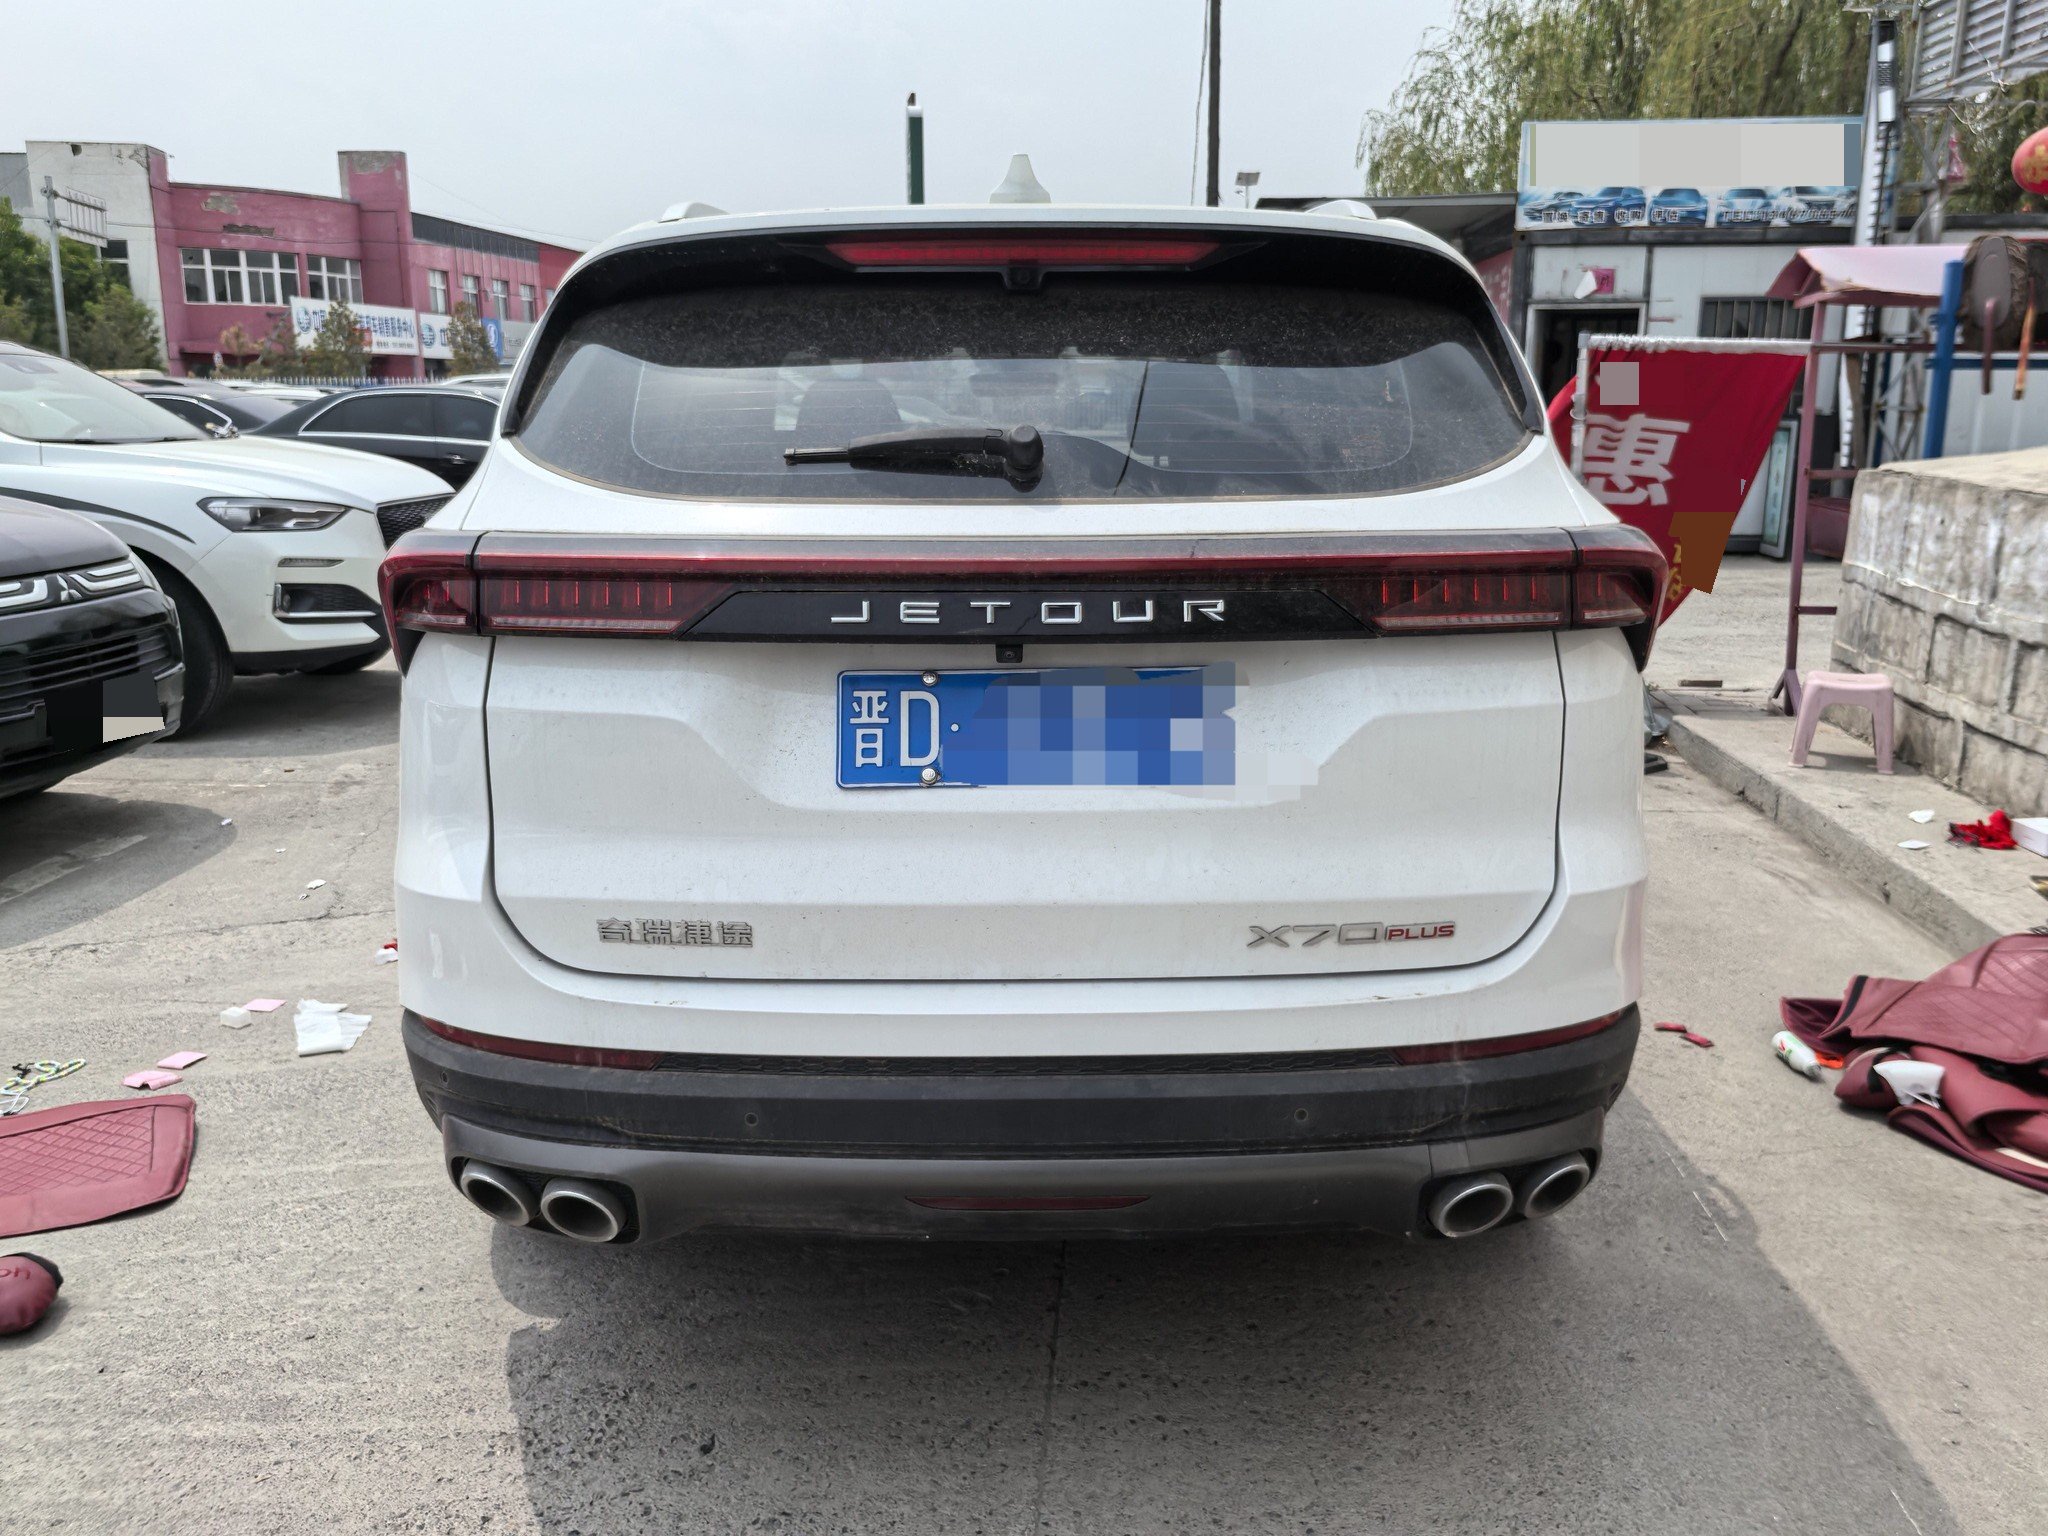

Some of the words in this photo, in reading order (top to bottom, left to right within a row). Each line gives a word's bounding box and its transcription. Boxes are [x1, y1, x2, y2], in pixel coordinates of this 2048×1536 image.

[831, 599, 1226, 624] JETOUR
[596, 917, 754, 948] 奇瑞捷途
[1246, 922, 1384, 948] X70
[1387, 922, 1456, 941] PLUS
